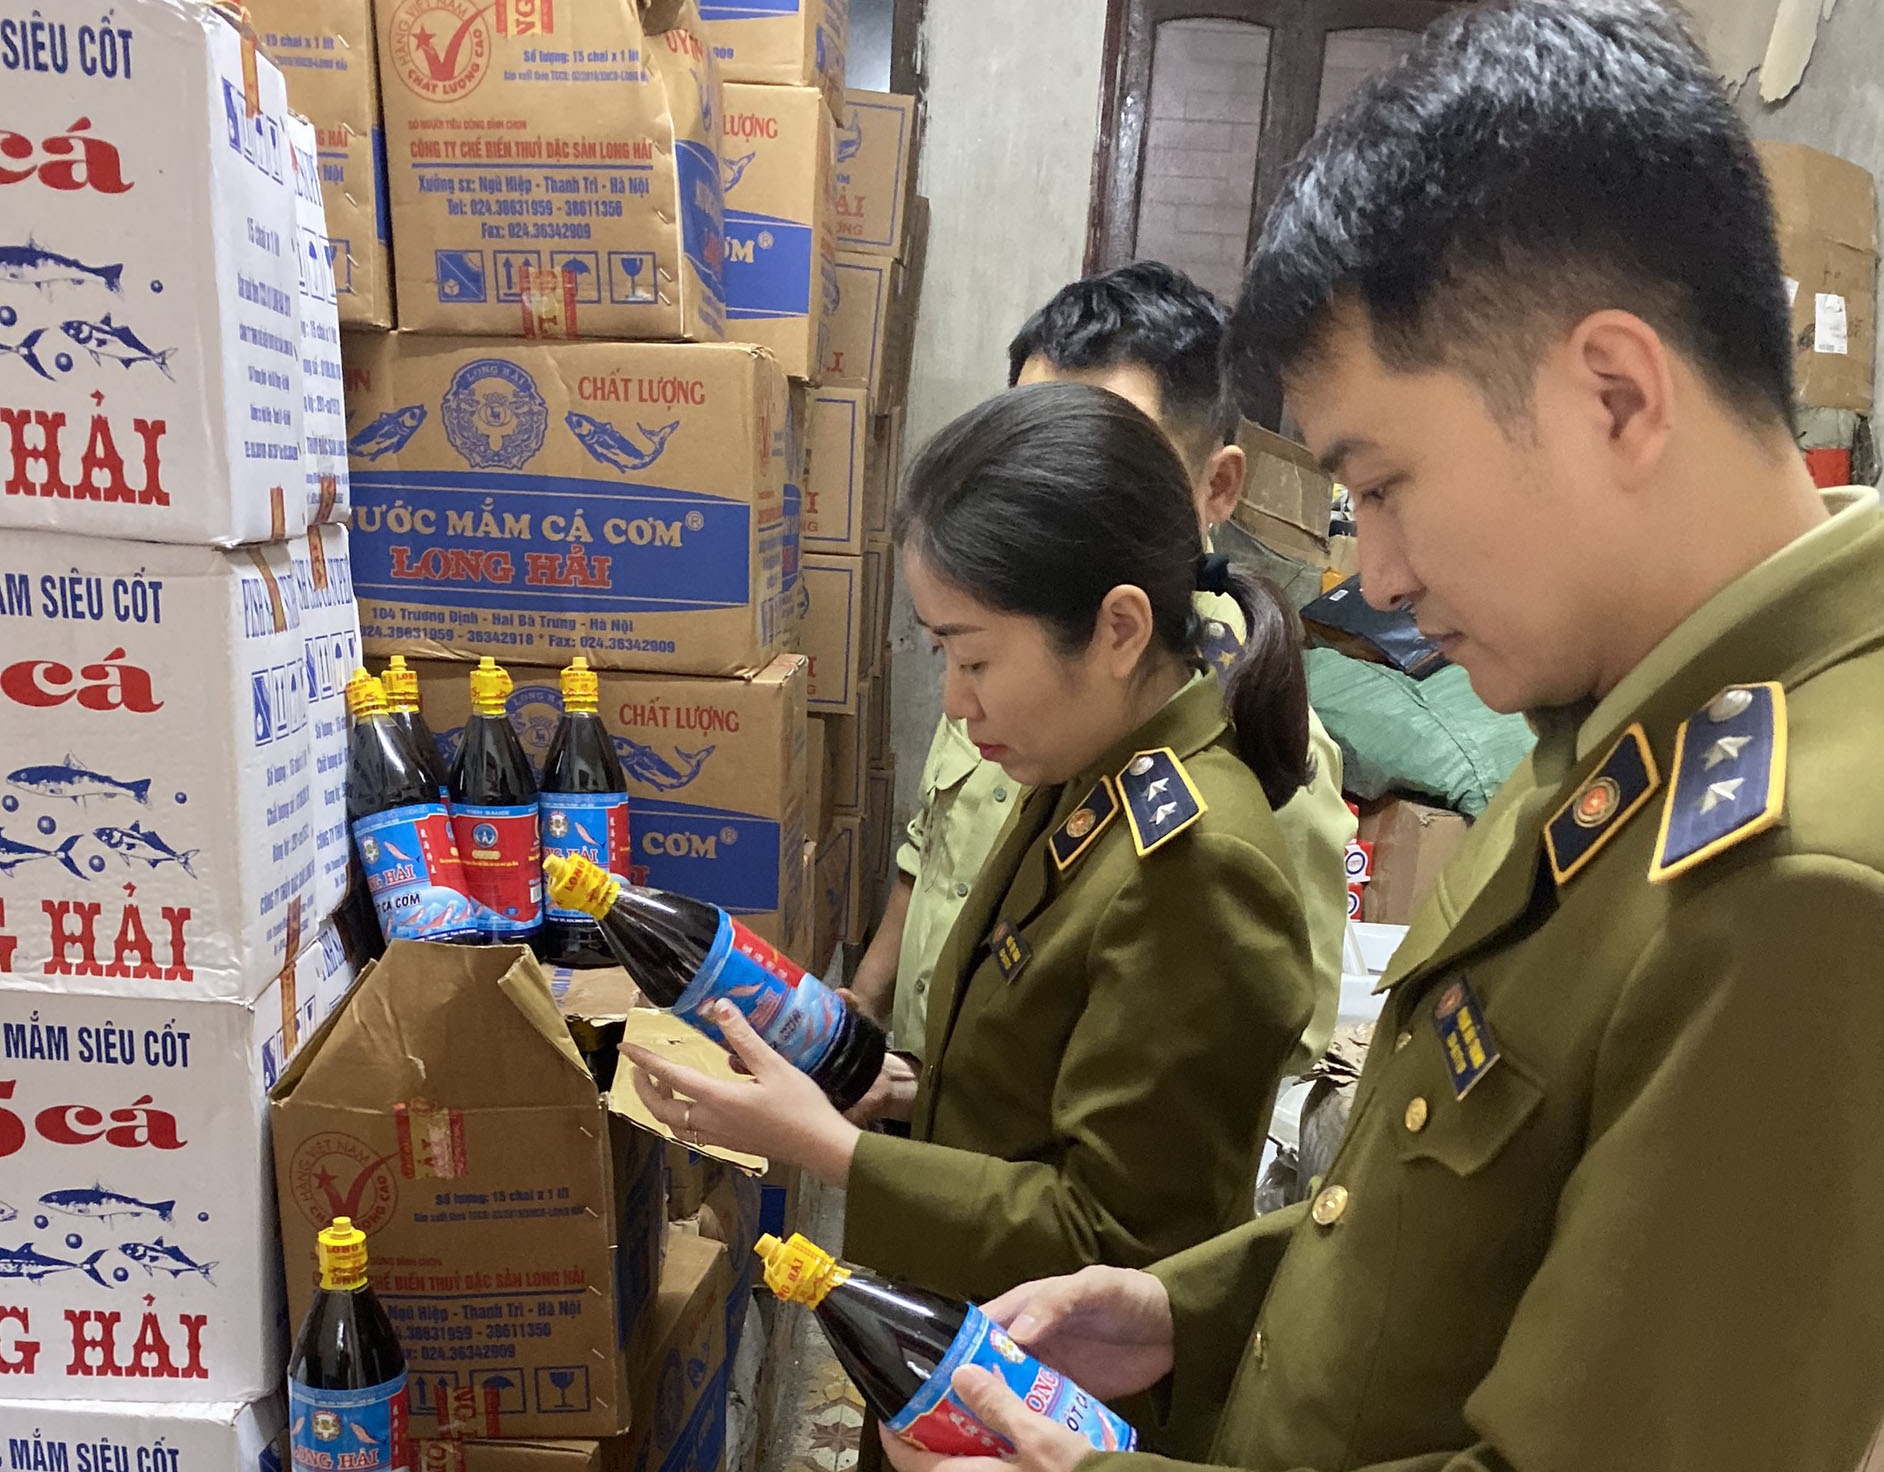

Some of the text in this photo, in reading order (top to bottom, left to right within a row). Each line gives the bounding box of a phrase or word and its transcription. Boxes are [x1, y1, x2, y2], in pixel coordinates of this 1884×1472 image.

[0, 8, 132, 80] SIÊU CỐT
[523, 49, 537, 62] Số
[573, 50, 584, 62] 15
[587, 50, 608, 62] chai
[722, 113, 778, 142] LƯỢNG
[410, 138, 441, 158] CÔNG
[444, 141, 456, 158] TY
[460, 136, 482, 158] CHẾ
[485, 136, 511, 158] BIẾN
[599, 142, 630, 159] LONG
[633, 137, 653, 160] HẢI
[458, 179, 475, 192] sx:
[543, 176, 580, 193] Thanh
[610, 176, 625, 194] Hà
[481, 222, 505, 239] Fax:
[577, 368, 706, 411] CHẤT LƯỢNG
[0, 389, 170, 507] HẢI
[350, 499, 436, 535] ƯỚC
[446, 496, 531, 539] MẮM
[541, 508, 593, 543] CÁ
[389, 546, 515, 584] LONG
[524, 544, 612, 590] HẢI
[40, 567, 103, 623] SIÊU
[113, 565, 163, 624] CỐT
[371, 607, 395, 620] 104
[450, 610, 478, 626] Định
[492, 612, 514, 627] Hai
[518, 614, 535, 627] Bà
[590, 617, 607, 631] Hà
[611, 618, 633, 634] Nội
[548, 633, 576, 648] Fax:
[0, 647, 165, 713] cá
[619, 696, 740, 736] CHẤT LƯỢNG
[383, 863, 416, 886] HẢI
[41, 881, 194, 982] HẢI
[3, 1010, 190, 1068] MẮM SIÊU CỐT
[526, 1271, 559, 1287] LONG
[462, 1303, 503, 1320] Thanh
[537, 1301, 555, 1317] Hà
[64, 1293, 208, 1379] HẢI
[9, 1427, 179, 1472] MẮM SIÊU CỐT
[338, 1447, 379, 1470] HẢI
